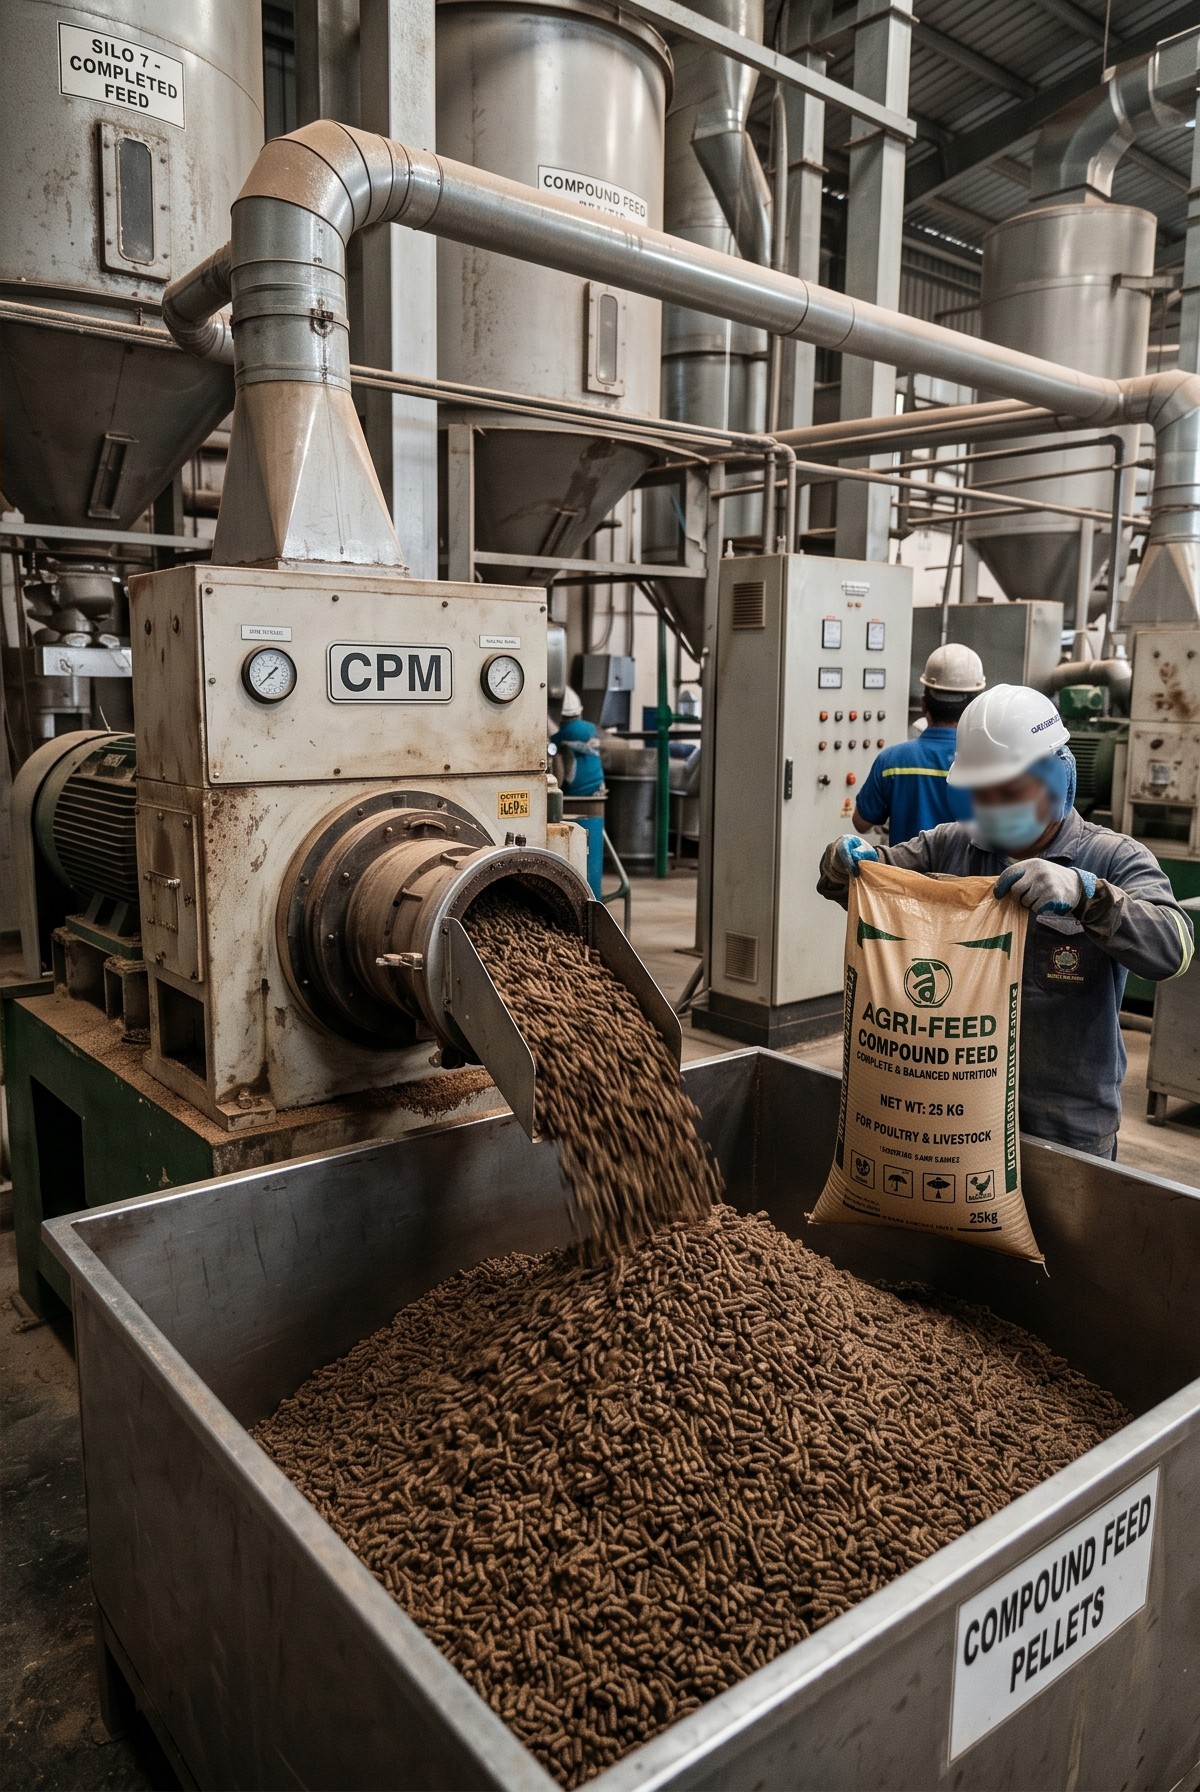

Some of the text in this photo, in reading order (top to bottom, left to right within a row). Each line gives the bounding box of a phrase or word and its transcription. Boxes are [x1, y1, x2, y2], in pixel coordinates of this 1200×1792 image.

[91, 38, 134, 63] SILO
[140, 53, 149, 68] 7
[69, 55, 178, 99] COMPLETED
[104, 83, 149, 108] FEED
[543, 174, 620, 205] COMPOUND
[623, 196, 646, 217] FEED
[340, 652, 442, 692] CPM
[861, 1001, 997, 1039] AGRI-FEED
[858, 1028, 998, 1065] COMPOUND FEED
[856, 1050, 998, 1081] COMPLETE & BALANCED NUTRITION
[880, 1093, 964, 1116] NET WT: 25 KG
[855, 1112, 992, 1145] FOR POULTRY & LIVESTOCK
[969, 1211, 998, 1224] 25kg
[963, 1494, 1152, 1666] COMPOUND FEED
[1010, 1585, 1106, 1693] PELLETS
